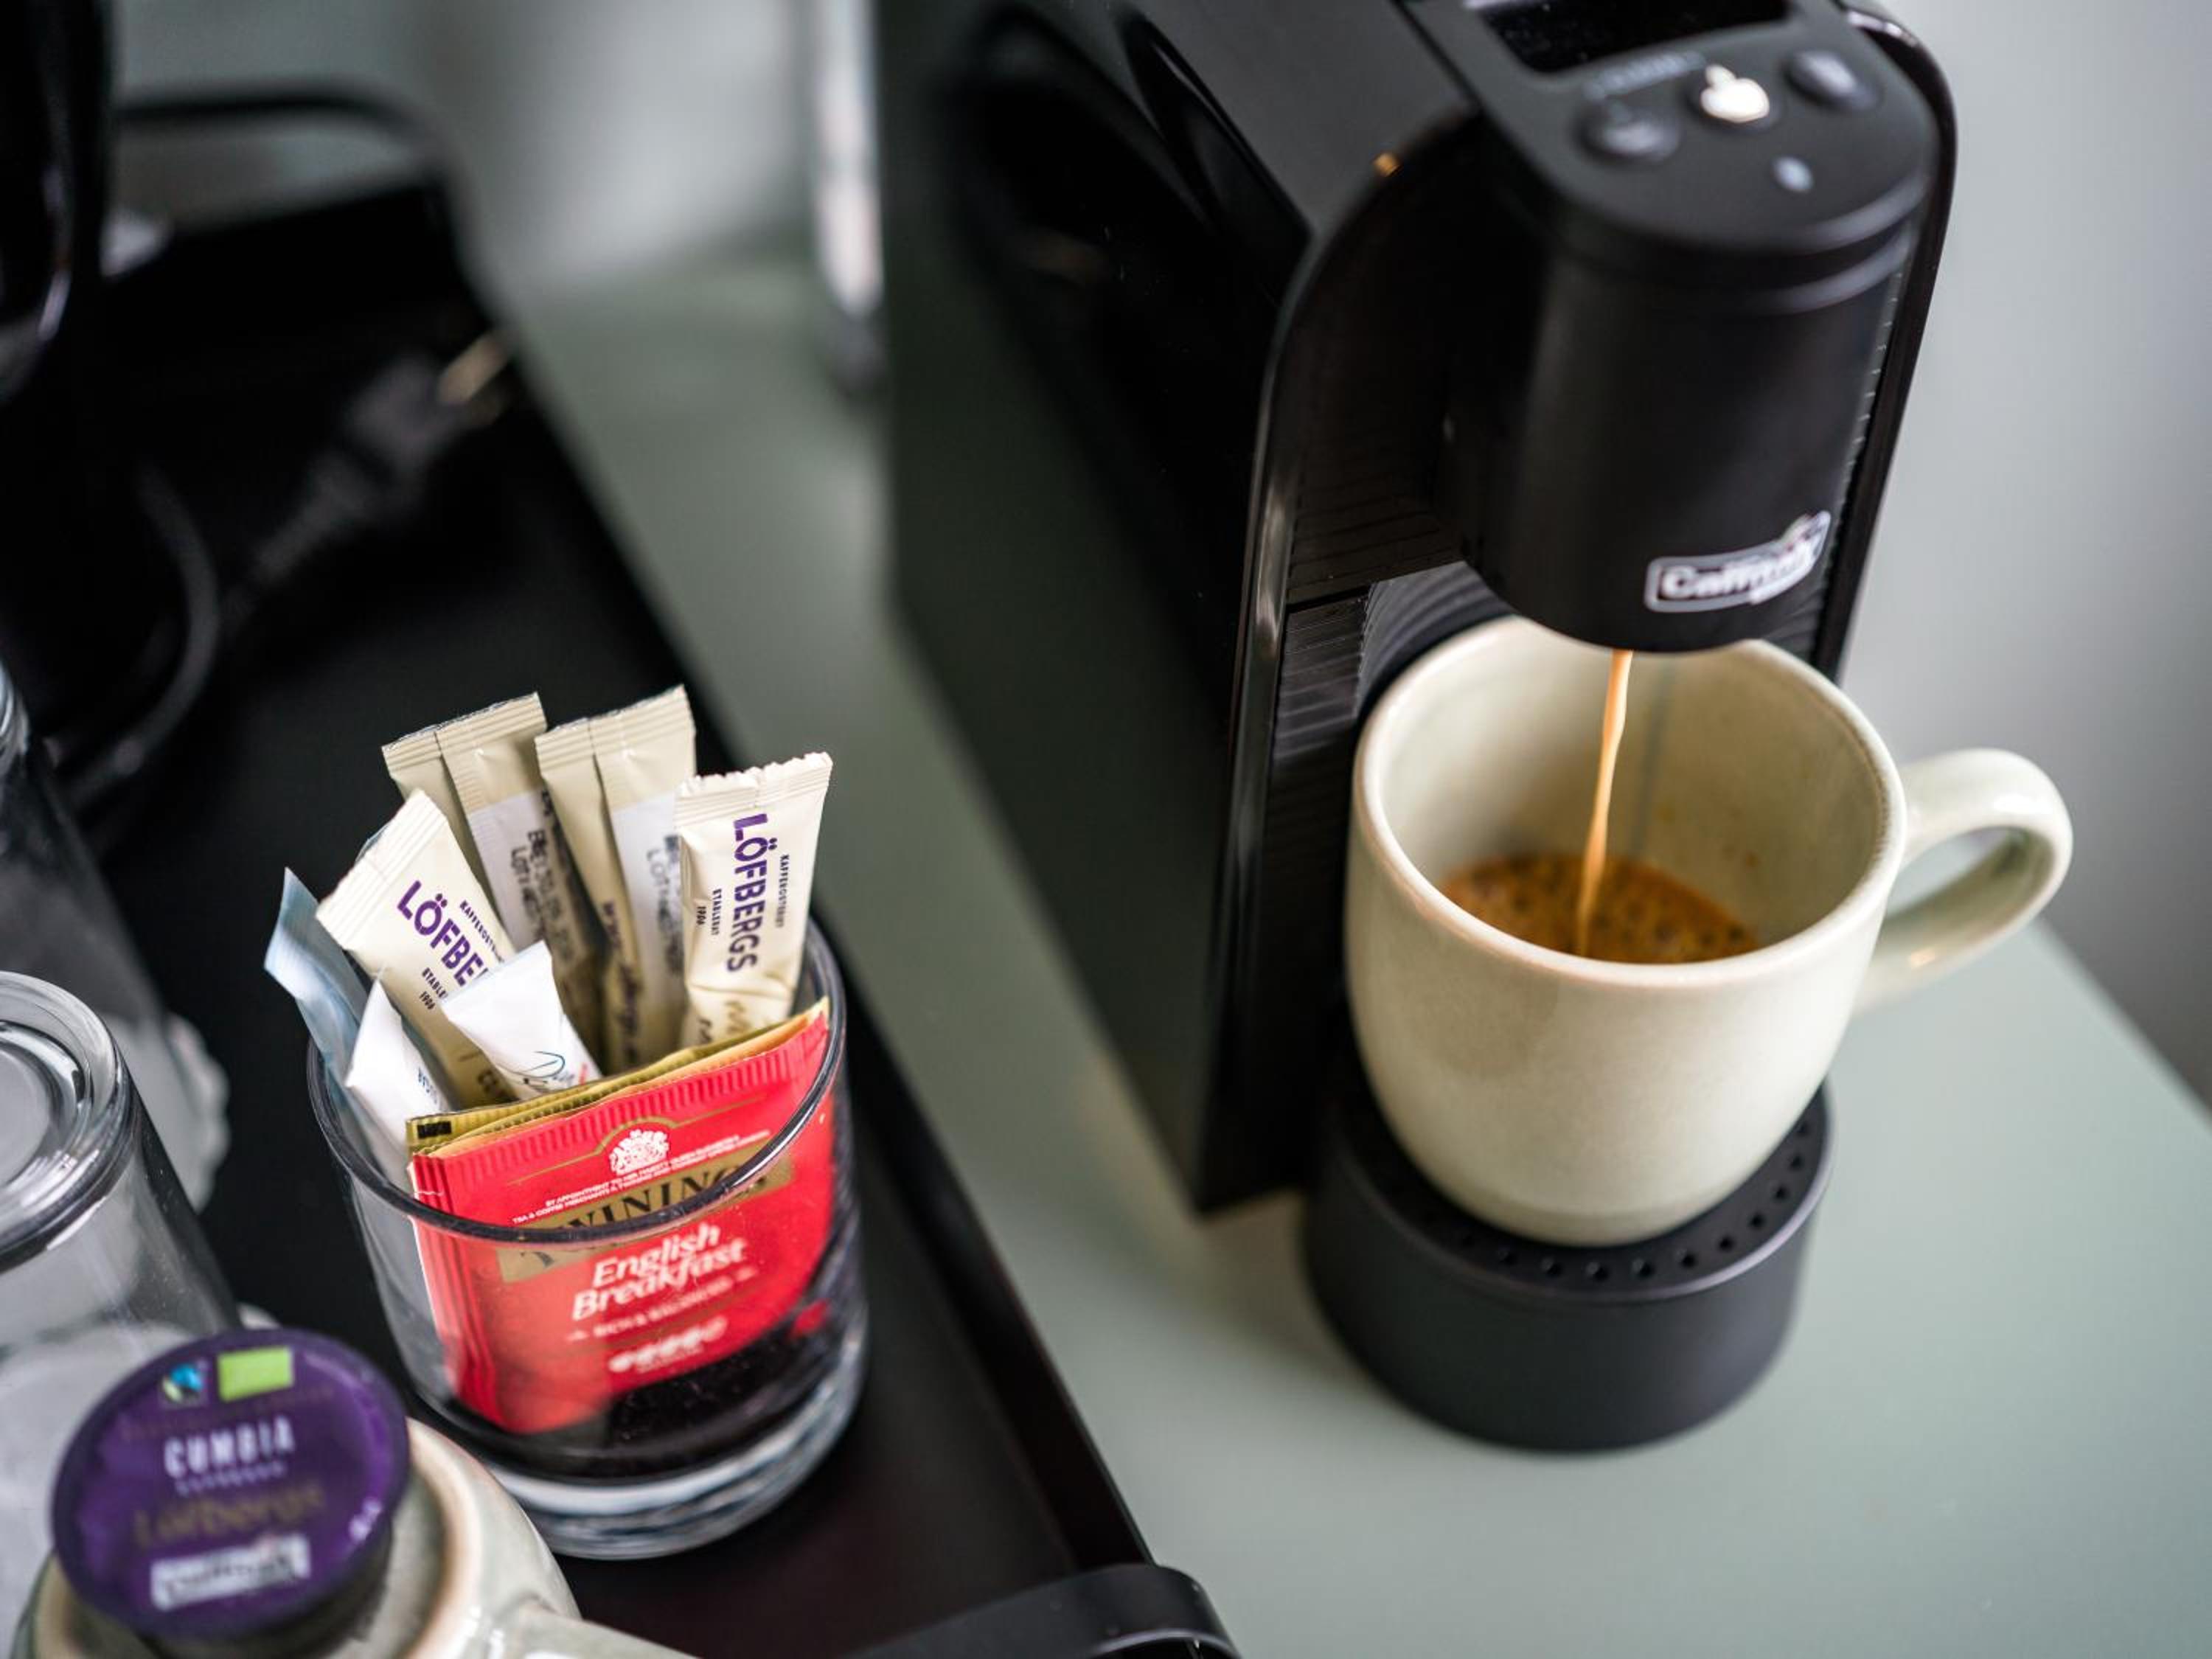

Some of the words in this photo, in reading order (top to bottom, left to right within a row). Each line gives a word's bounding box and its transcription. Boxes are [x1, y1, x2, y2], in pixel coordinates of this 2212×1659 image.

[397, 880, 488, 987] LÖFBE
[727, 813, 778, 972] LÖFBERGS
[422, 967, 448, 999] ETABLE
[572, 1238, 747, 1321] Breakfast
[593, 1222, 720, 1288] English
